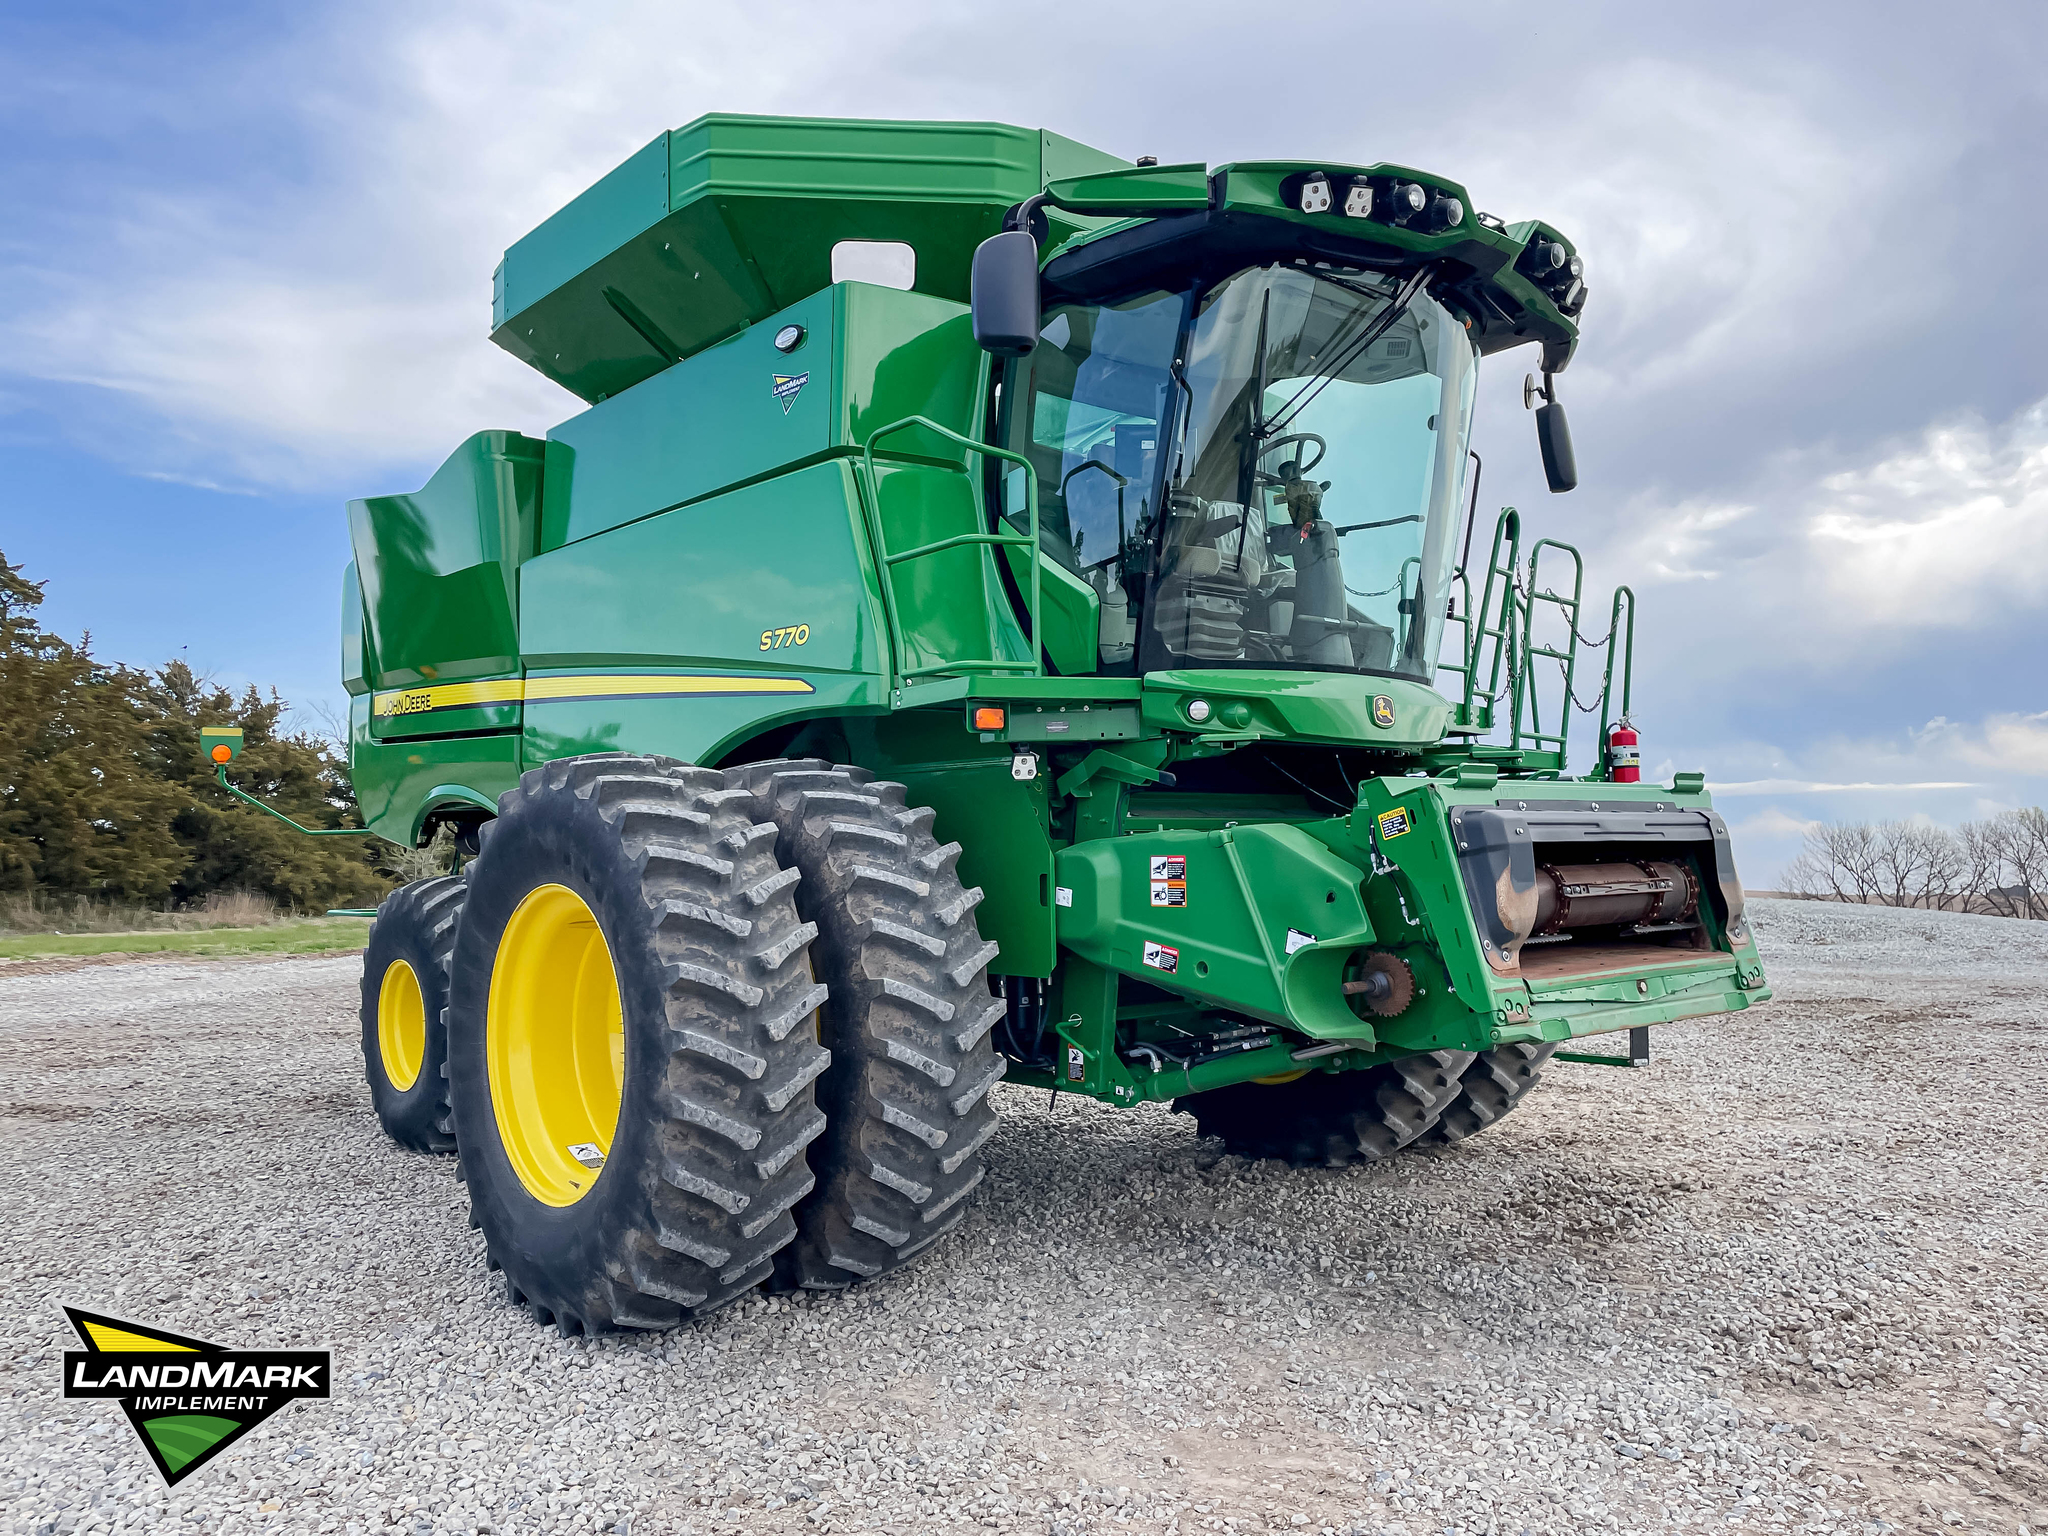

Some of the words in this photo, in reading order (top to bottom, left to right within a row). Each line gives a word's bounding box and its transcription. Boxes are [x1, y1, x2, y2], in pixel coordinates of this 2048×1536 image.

[773, 375, 808, 395] LANDMARK
[759, 623, 810, 652] S770
[383, 697, 404, 715] JOHN
[405, 694, 432, 712] DEERE
[1383, 809, 1404, 820] CAUTION
